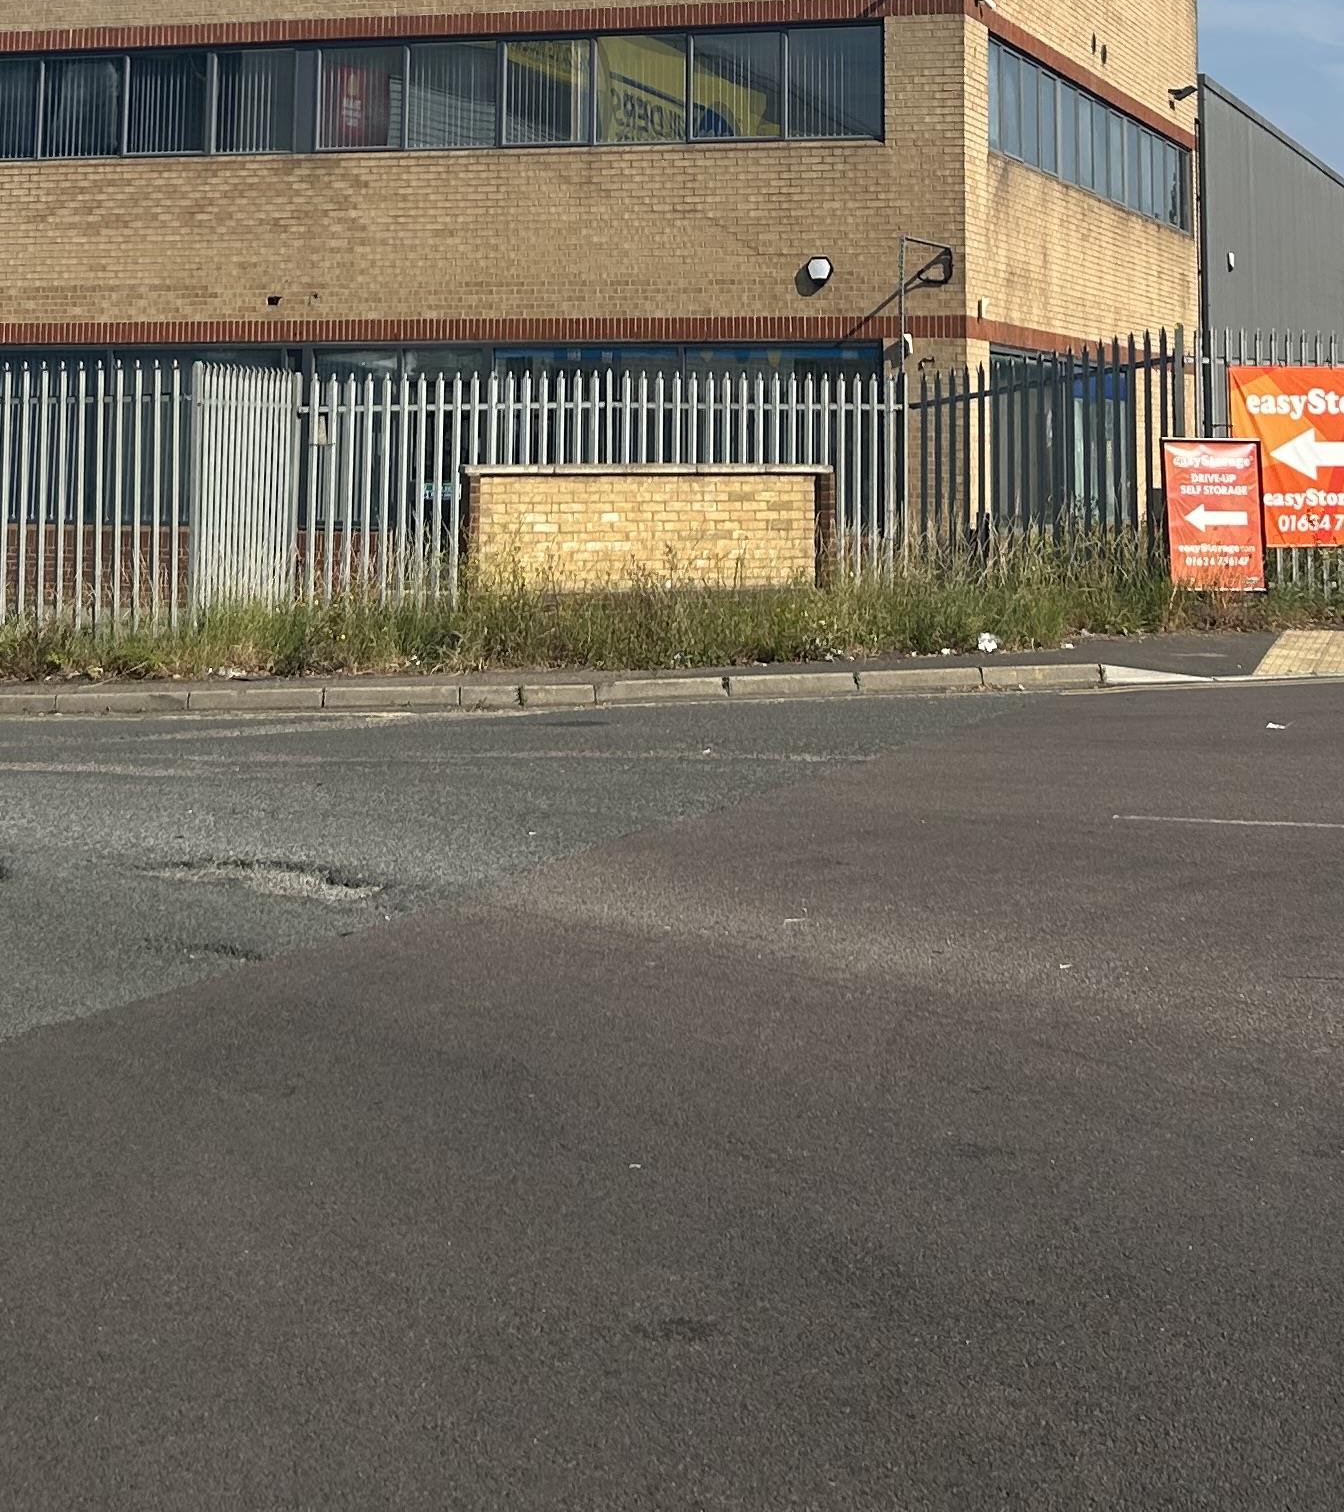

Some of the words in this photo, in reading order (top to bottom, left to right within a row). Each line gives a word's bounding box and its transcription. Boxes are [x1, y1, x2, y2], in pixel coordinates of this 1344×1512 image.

[1190, 473, 1237, 483] DRIVE-UP
[1180, 485, 1202, 495] SELF
[1203, 485, 1248, 496] STORAGE
[1278, 514, 1331, 532] 01634
